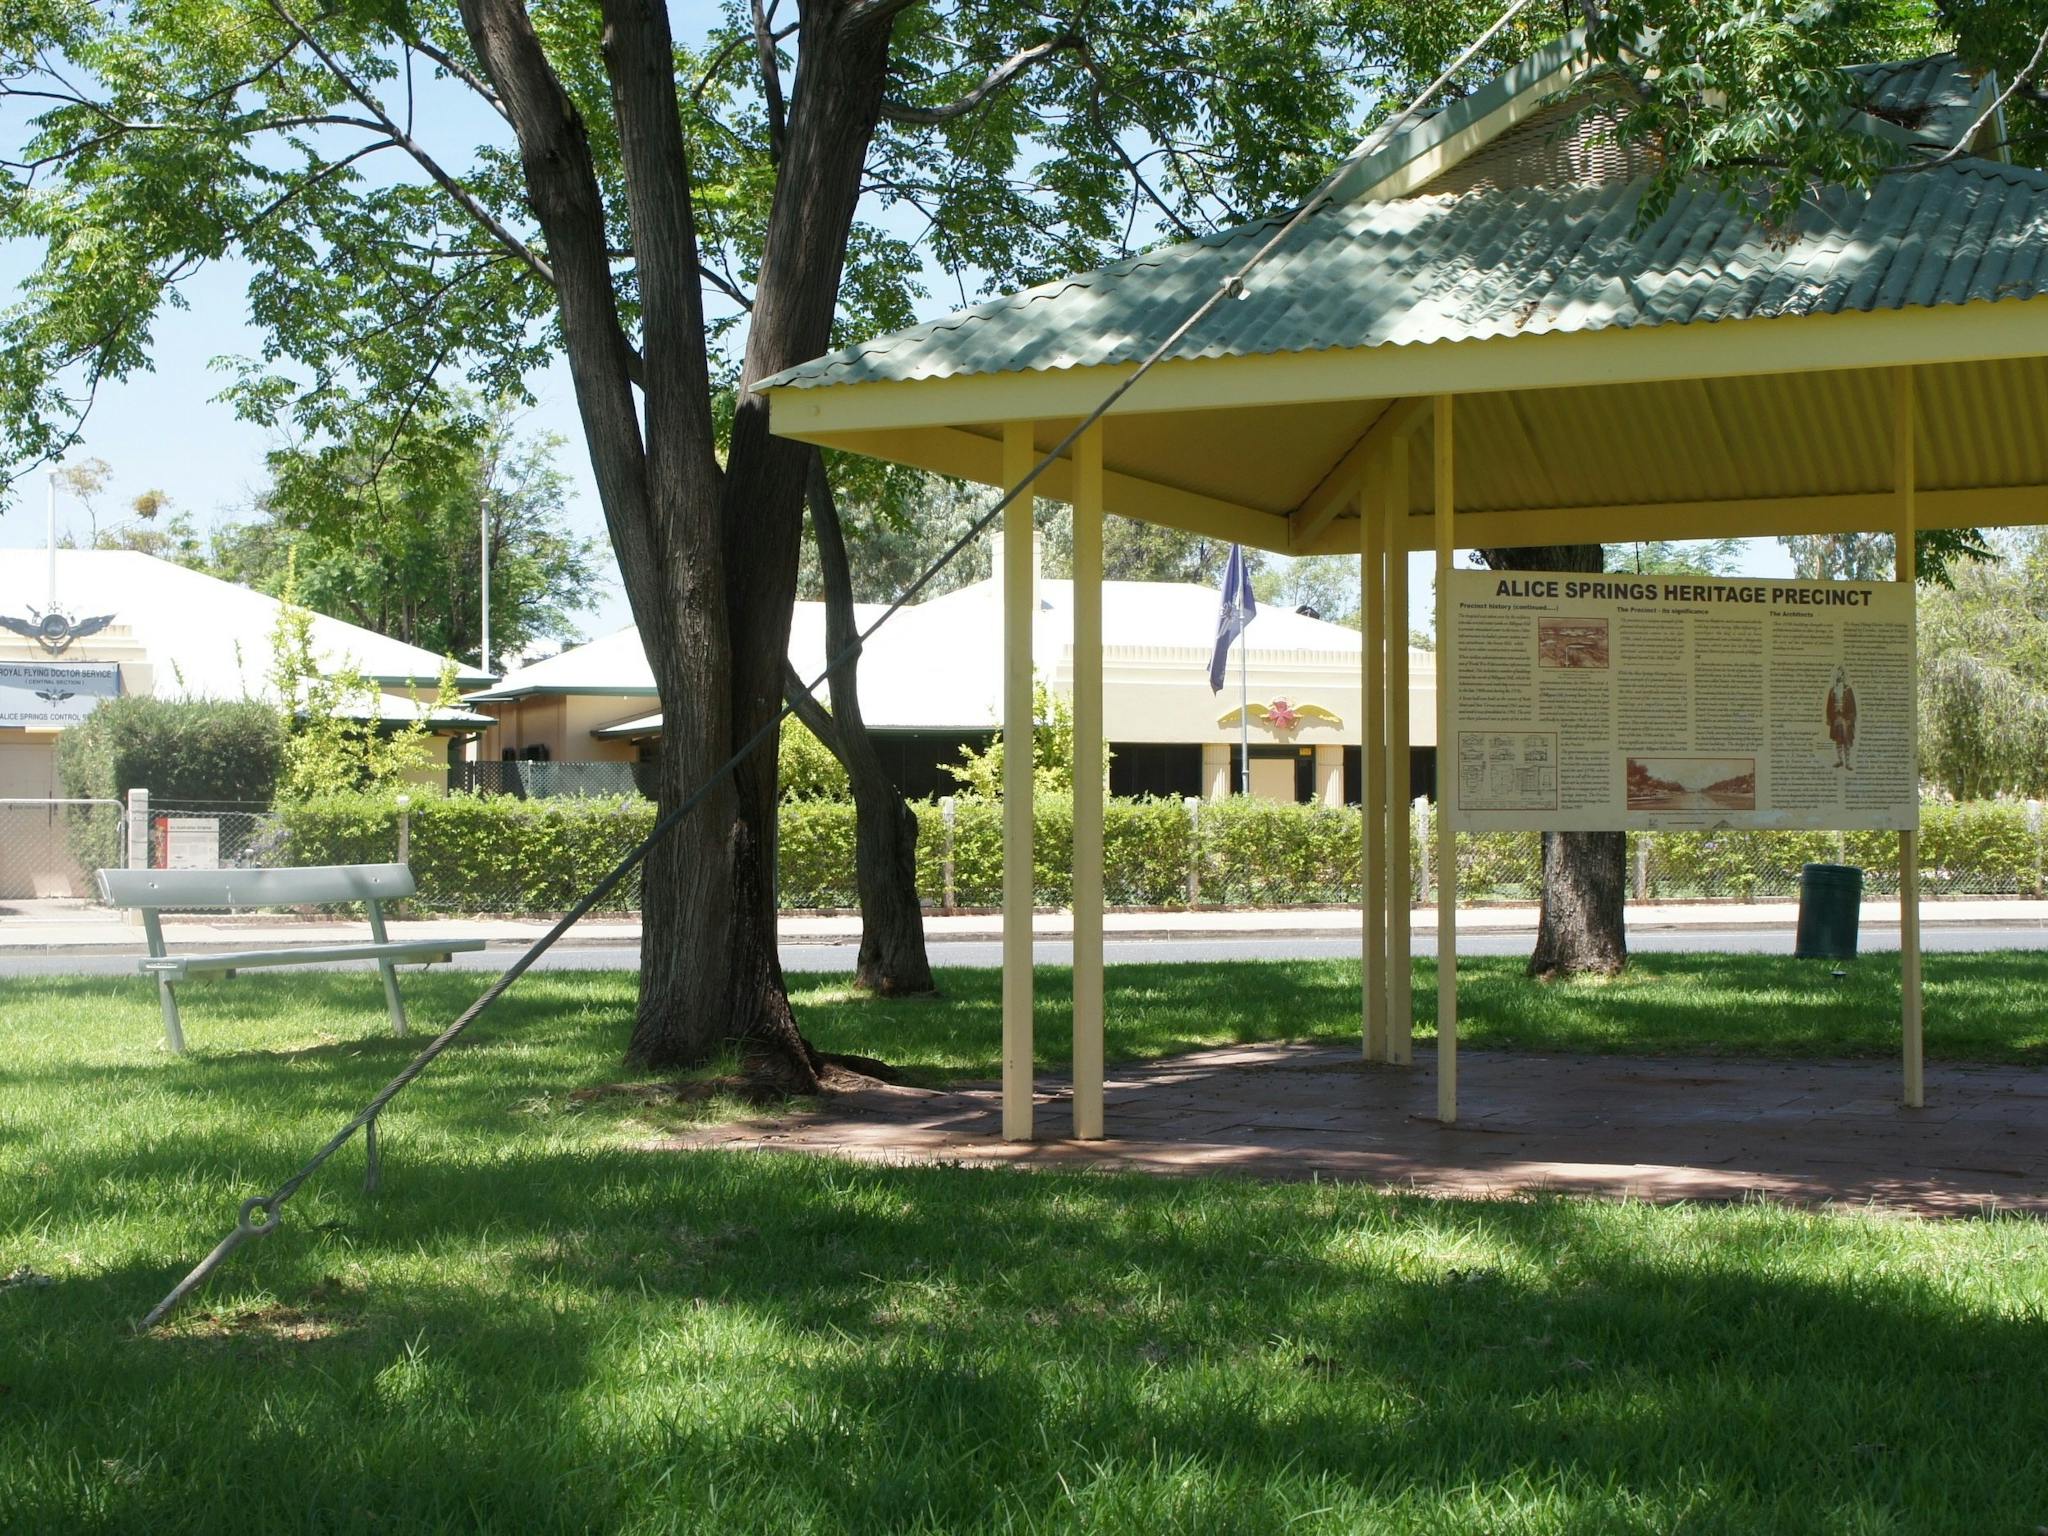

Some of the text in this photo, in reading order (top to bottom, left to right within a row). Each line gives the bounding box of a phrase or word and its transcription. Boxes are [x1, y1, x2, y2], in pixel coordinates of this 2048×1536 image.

[1495, 580, 1873, 606] ALICE SPRINGS HERITAGE PRECINCT
[1488, 603, 1512, 611] history
[1671, 608, 1709, 616] significance
[23, 669, 49, 678] FLYING
[50, 669, 81, 678] DOCTOR
[81, 670, 112, 679] SERVICE
[20, 713, 48, 721] SPRINGS
[50, 713, 81, 721] CONTROL
